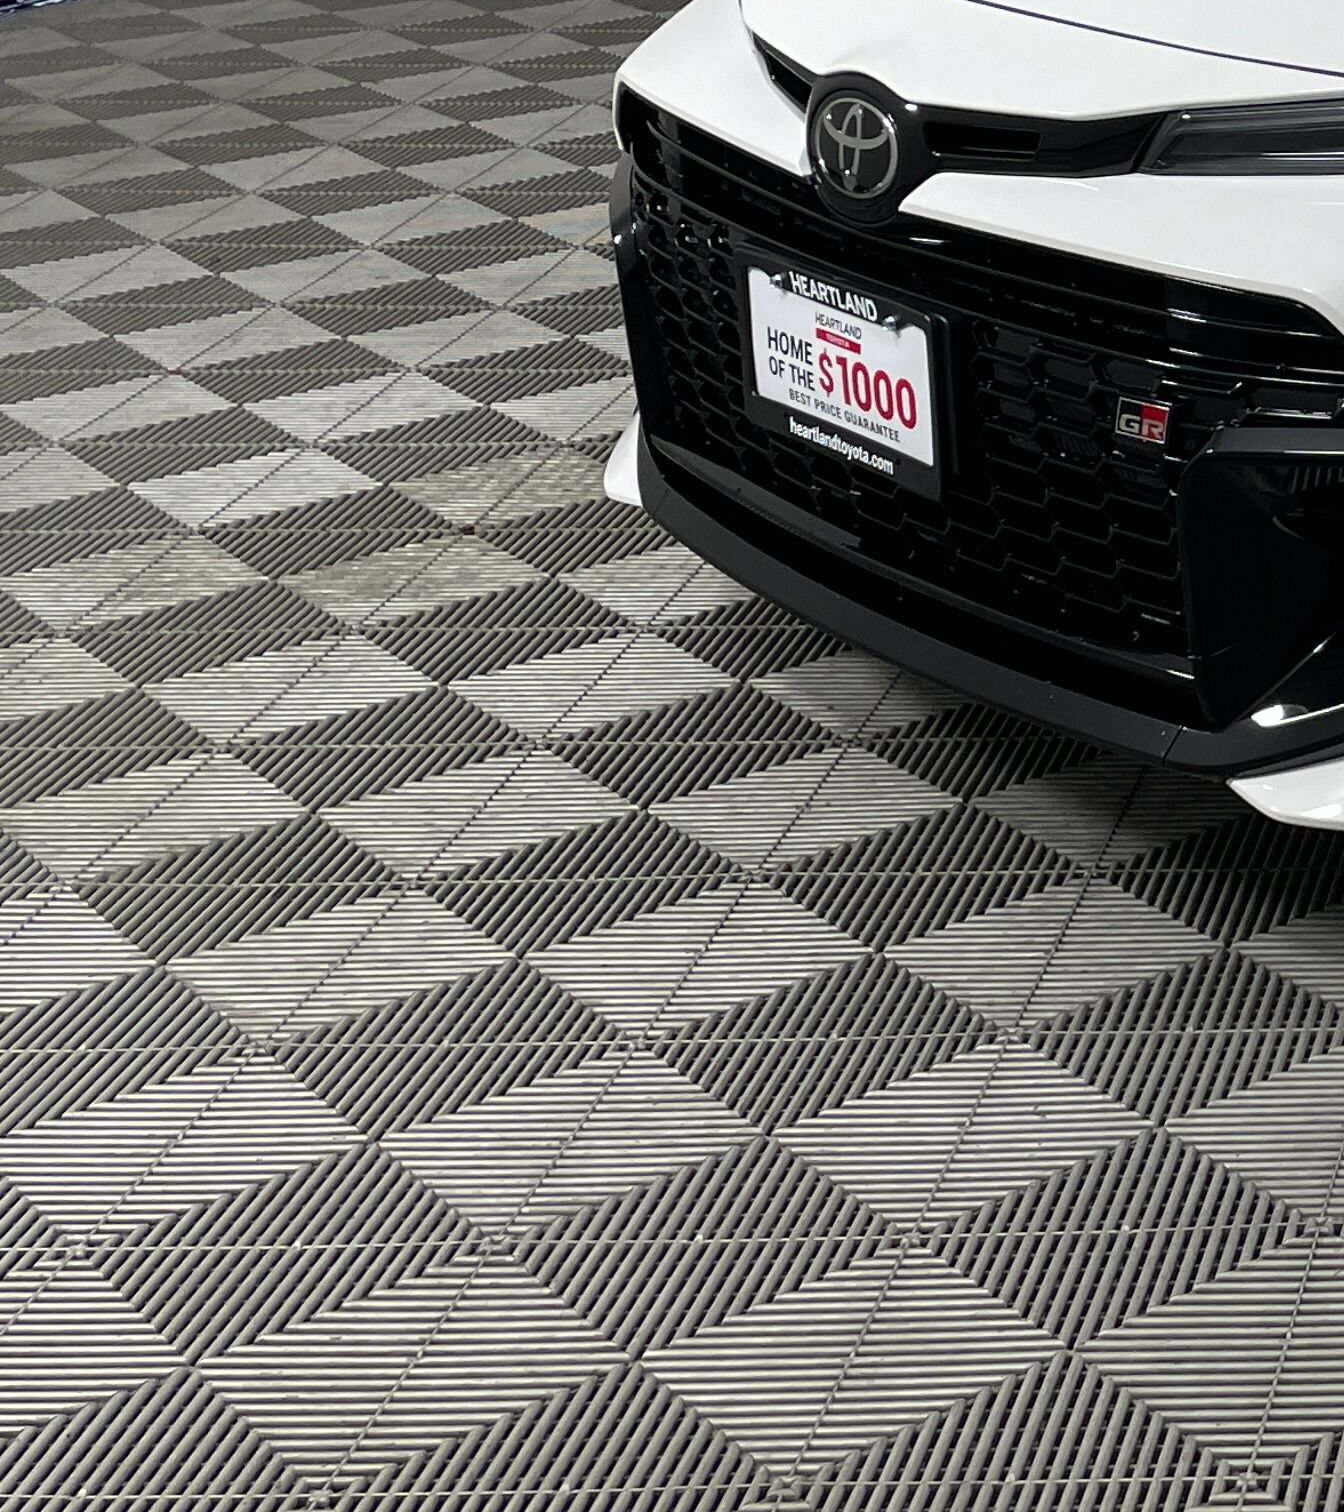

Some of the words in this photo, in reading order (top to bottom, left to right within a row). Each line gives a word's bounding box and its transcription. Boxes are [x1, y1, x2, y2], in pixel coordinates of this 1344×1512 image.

[789, 271, 877, 321] HEARTLAND
[767, 326, 813, 366] HOME
[815, 311, 862, 340] HEARTLAND
[769, 356, 785, 378] OF
[789, 363, 815, 391] THE
[818, 348, 917, 430] $1000
[789, 388, 811, 406] BEST
[814, 399, 842, 420] PRICE
[844, 410, 900, 442] GUARANTEE
[1119, 413, 1163, 440] GR
[789, 416, 894, 475] heartlandtoyota.com
